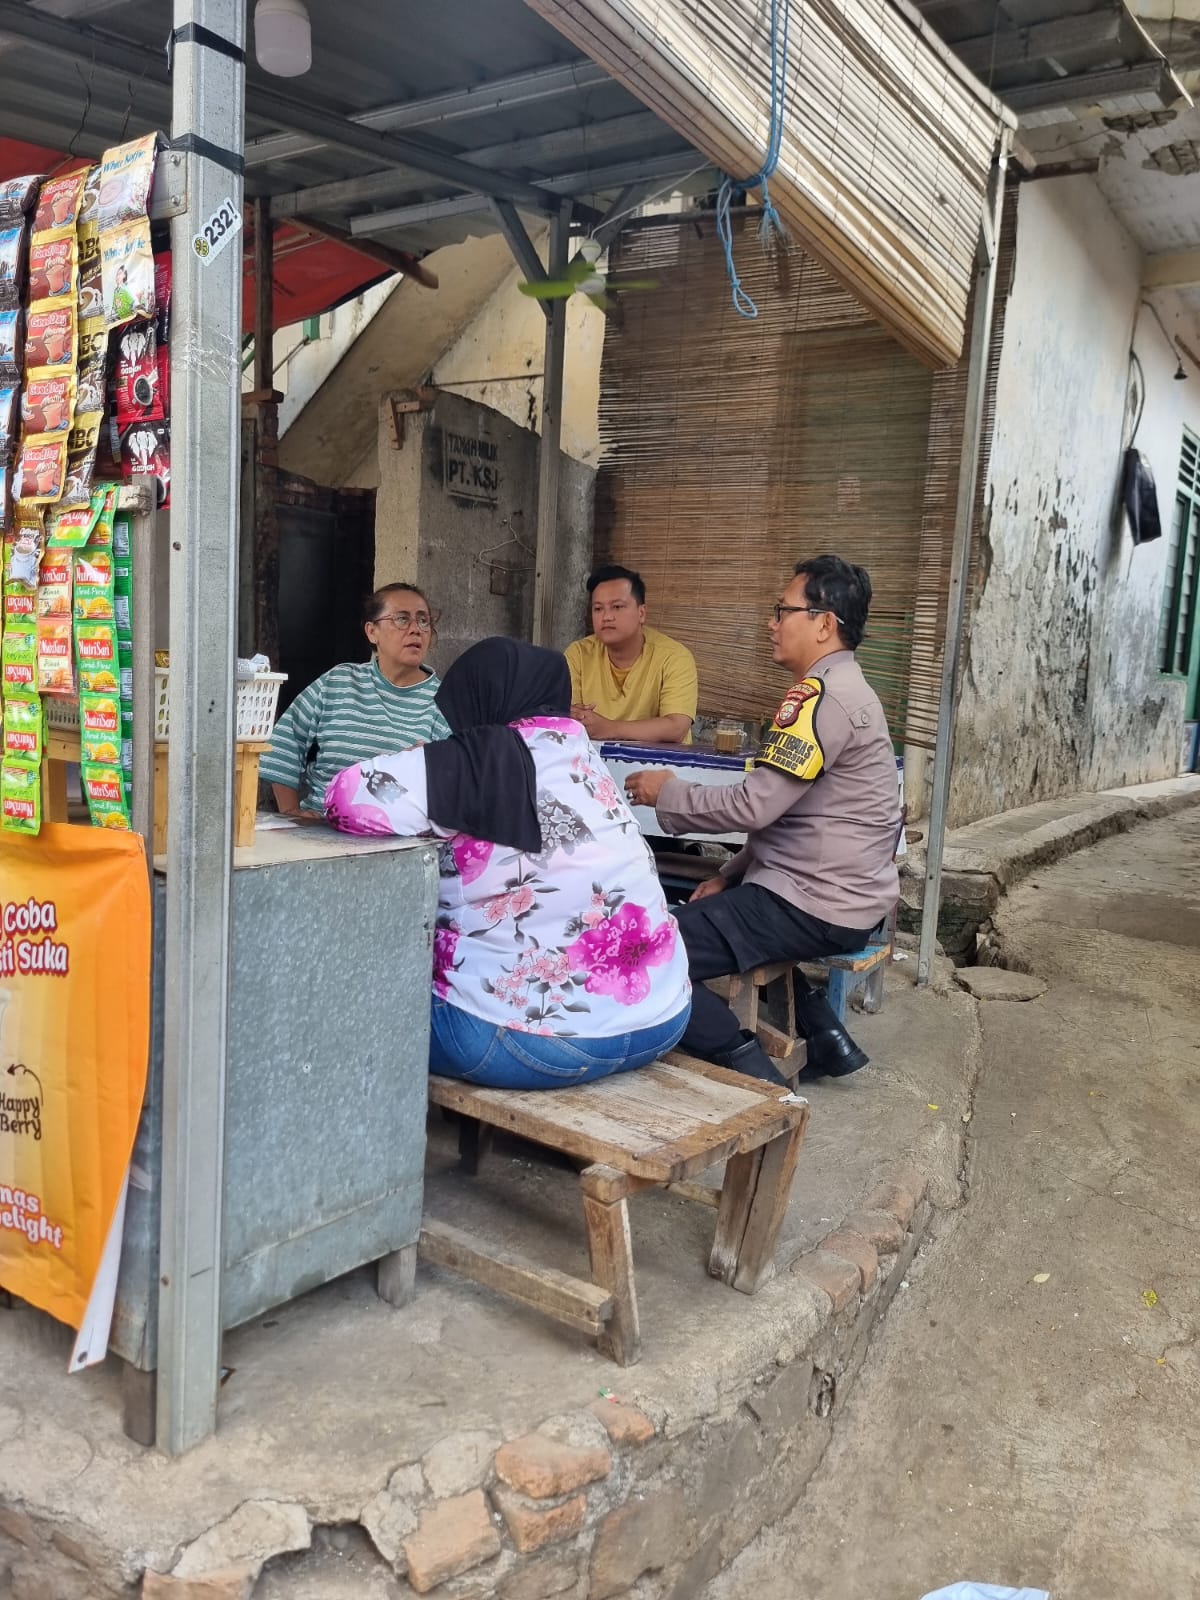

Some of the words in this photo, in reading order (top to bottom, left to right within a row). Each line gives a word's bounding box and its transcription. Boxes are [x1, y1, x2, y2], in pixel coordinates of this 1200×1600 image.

[204, 201, 238, 247] 232!
[79, 331, 105, 354] BC
[4, 897, 57, 933] Coba
[17, 937, 68, 974] Suka
[0, 1092, 40, 1119] Happy
[0, 1113, 42, 1140] Berry
[0, 1205, 62, 1249] elight
